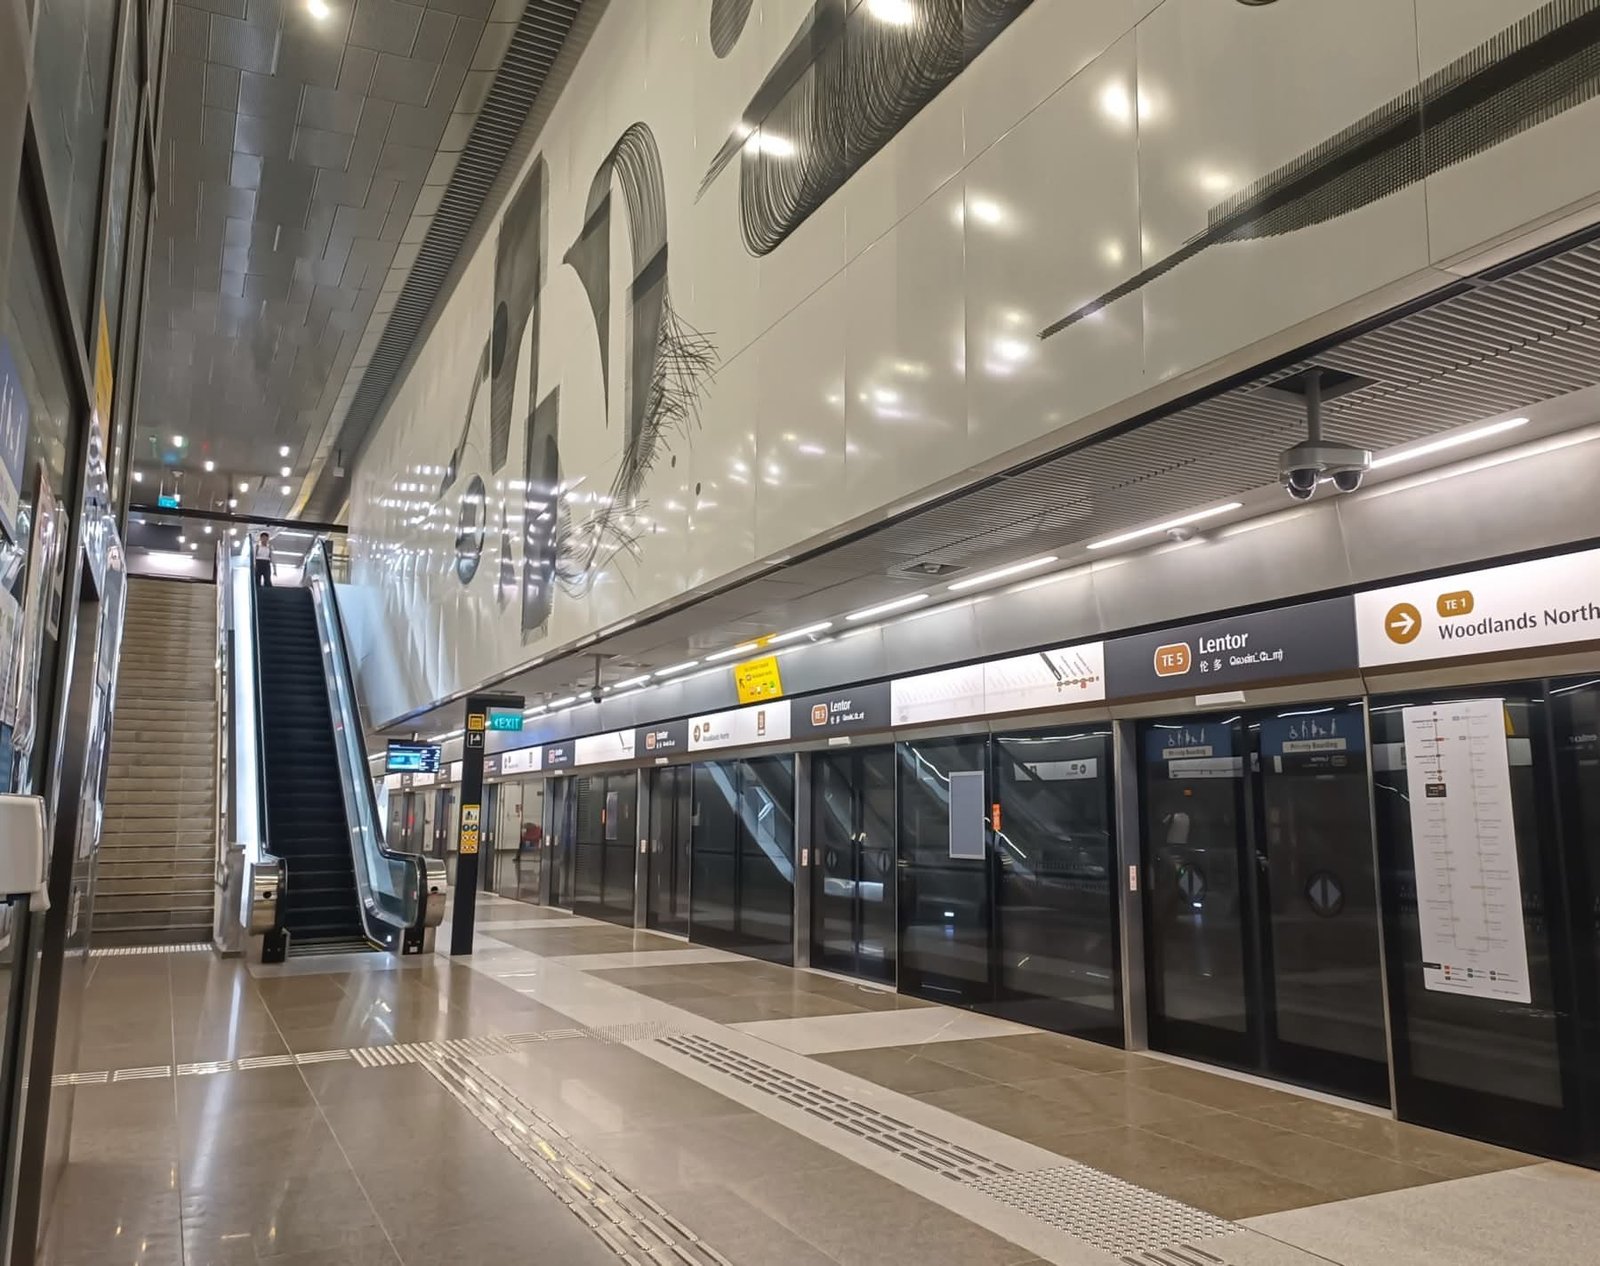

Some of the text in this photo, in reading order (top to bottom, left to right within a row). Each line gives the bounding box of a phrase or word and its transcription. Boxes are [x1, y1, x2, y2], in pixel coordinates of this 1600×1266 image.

[1444, 598, 1467, 611] TE 1
[1438, 602, 1600, 640] Woodlands North
[1199, 633, 1249, 655] Lentor
[1161, 652, 1184, 667] TE 5
[500, 717, 520, 729] EXIT
